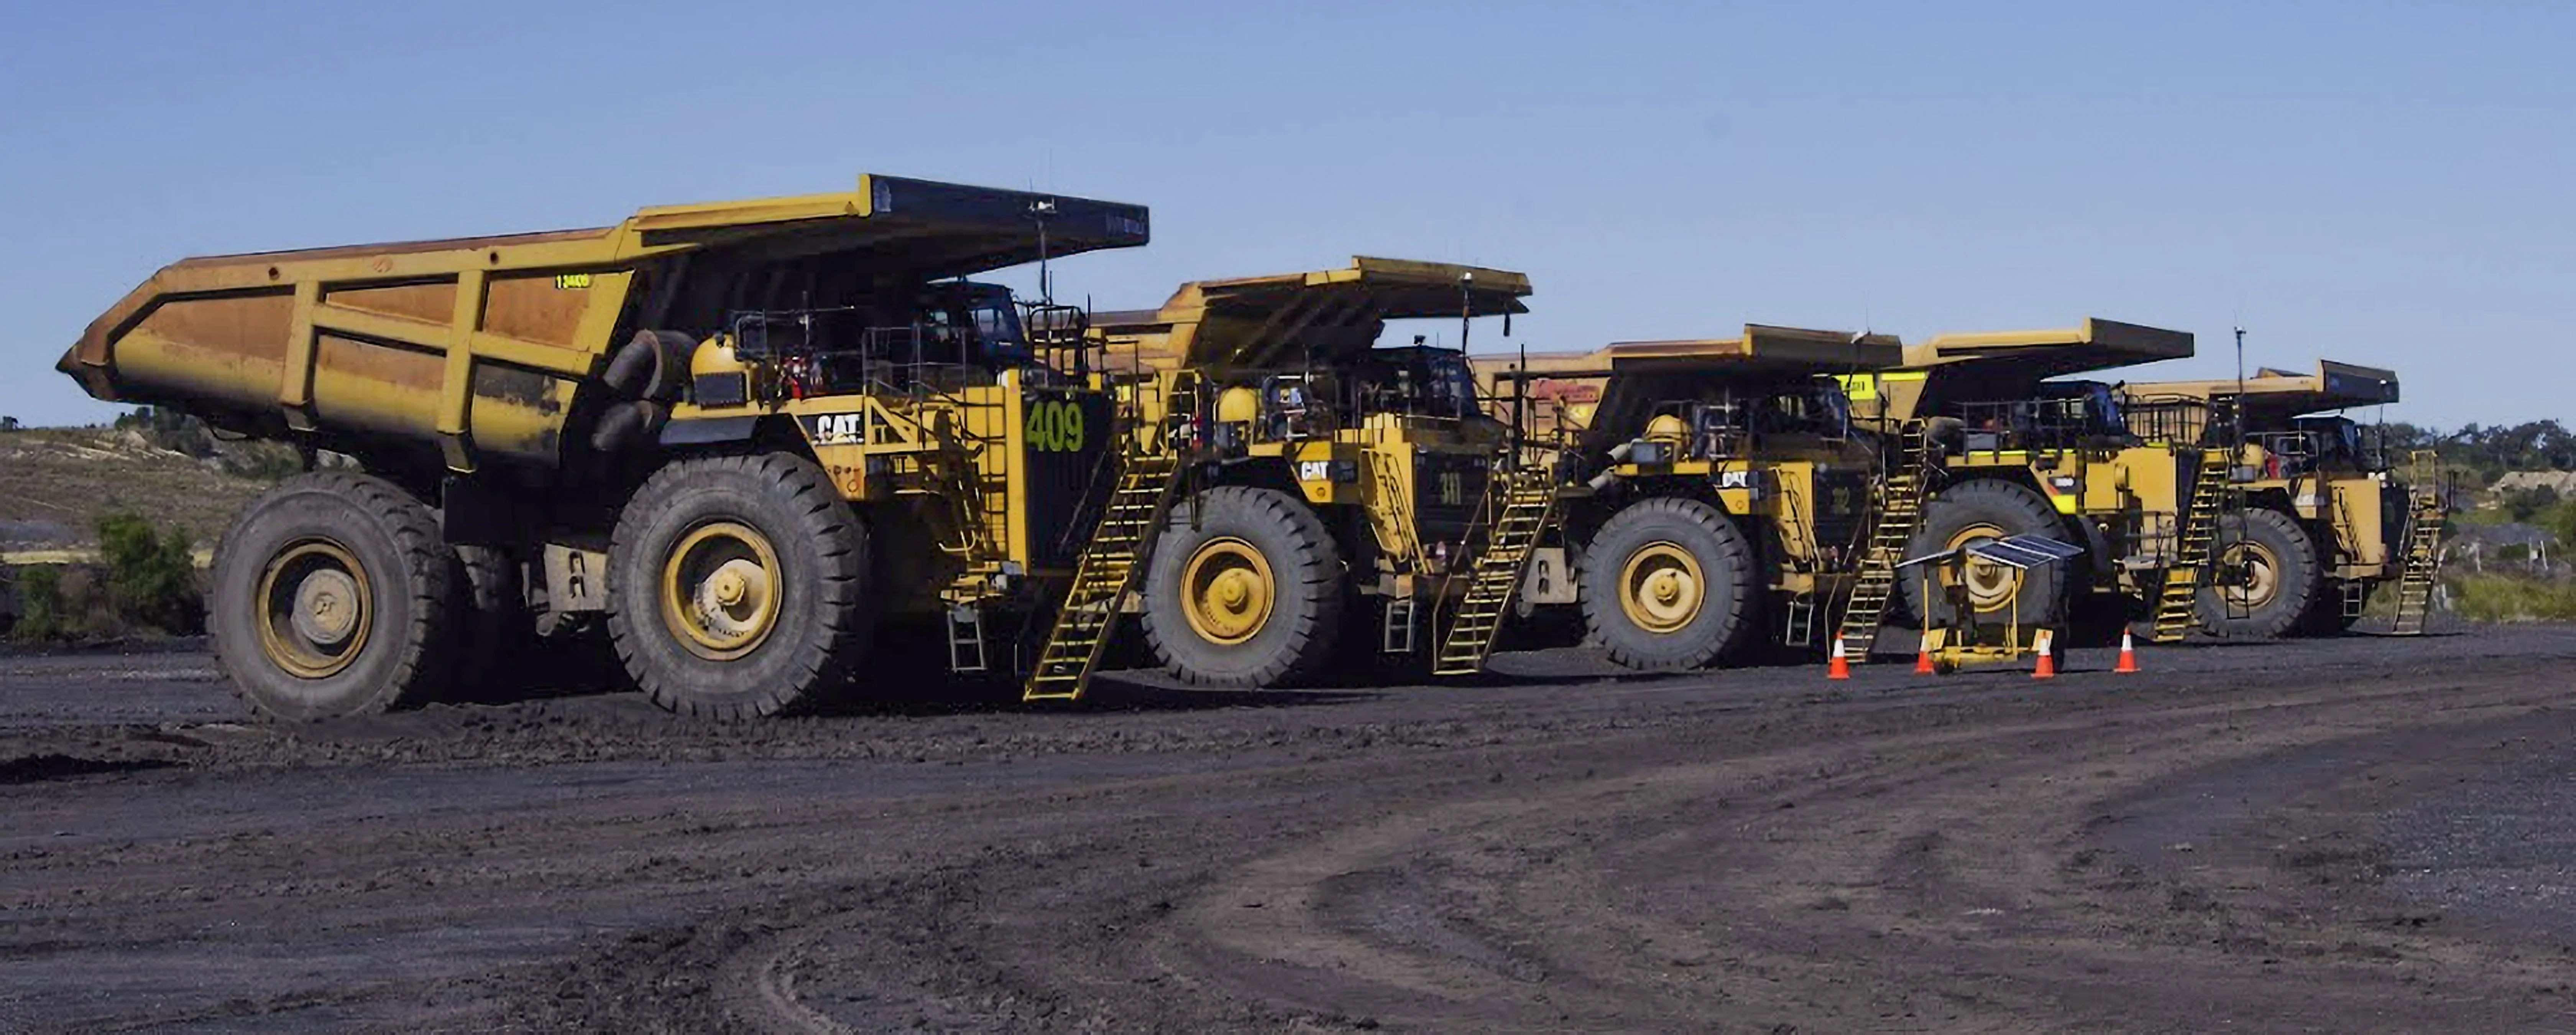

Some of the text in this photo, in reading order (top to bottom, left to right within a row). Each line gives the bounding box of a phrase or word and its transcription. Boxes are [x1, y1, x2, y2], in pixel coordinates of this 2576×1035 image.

[817, 414, 860, 444] CAT
[1026, 400, 1083, 452] 409
[1301, 461, 1329, 480] CAT
[1722, 471, 1747, 487] CAT
